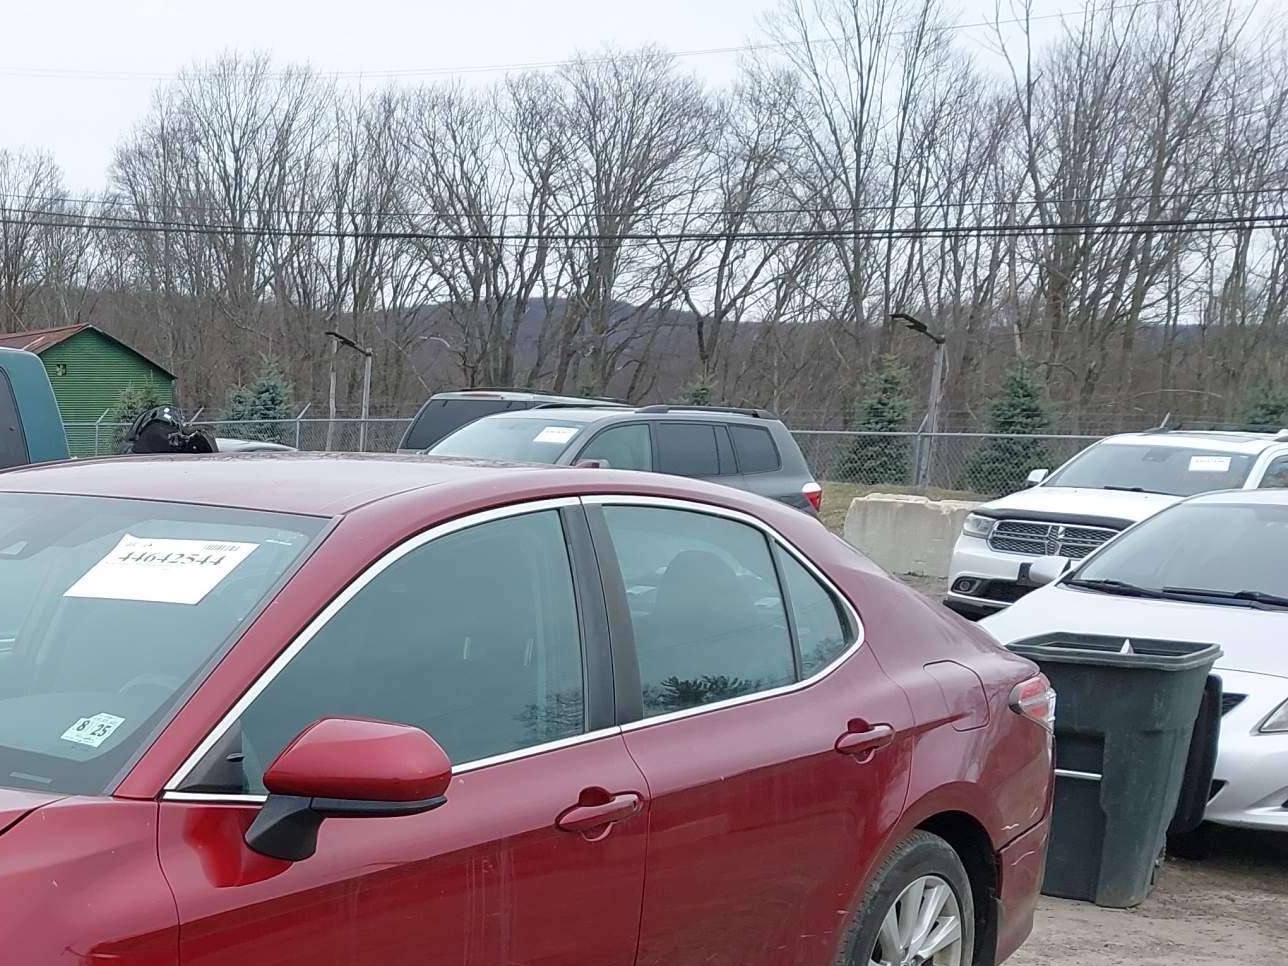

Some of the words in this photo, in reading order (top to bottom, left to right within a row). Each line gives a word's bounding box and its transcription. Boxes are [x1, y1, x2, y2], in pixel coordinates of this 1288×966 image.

[117, 551, 227, 566] 44642544
[76, 720, 90, 732] 8
[90, 724, 112, 737] 25
